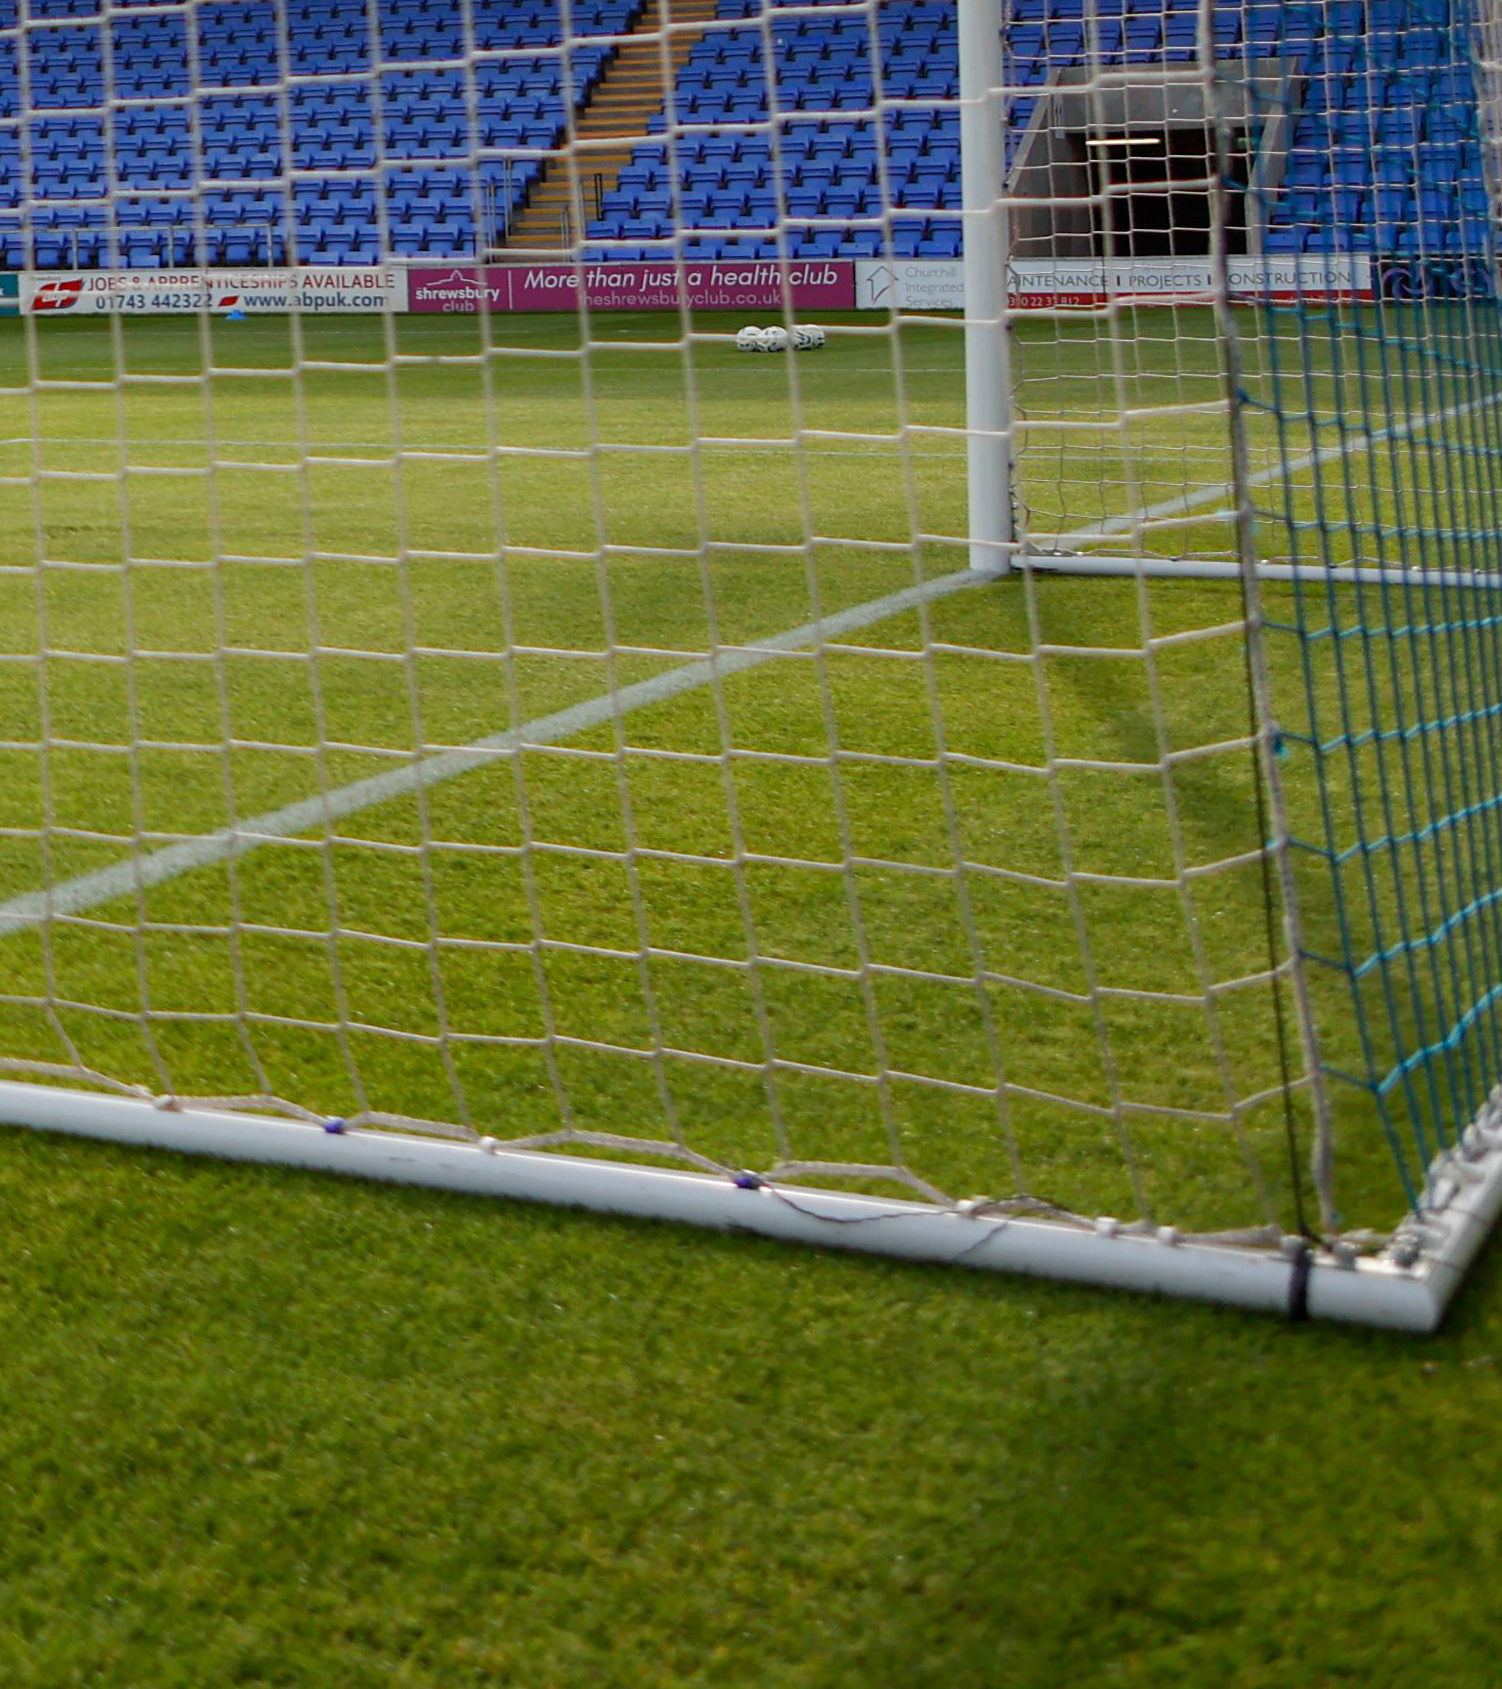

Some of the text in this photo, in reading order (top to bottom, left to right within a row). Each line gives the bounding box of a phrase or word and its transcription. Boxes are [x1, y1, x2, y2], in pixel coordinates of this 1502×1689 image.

[524, 264, 838, 292] More than just a health club
[905, 266, 957, 278] Churchill
[88, 277, 127, 291] JOBS
[302, 274, 395, 289] AVAILABLE
[1007, 272, 1351, 289] AINTENANCE PROJECTS ONSTRUCTION
[415, 286, 500, 301] shrewsbury
[905, 282, 965, 295] Integrated
[96, 294, 145, 309] 01743
[151, 293, 213, 308] 442322
[443, 300, 474, 311] club
[580, 289, 782, 308] heshrewsbuyclub.co.uk
[905, 296, 954, 307] Services
